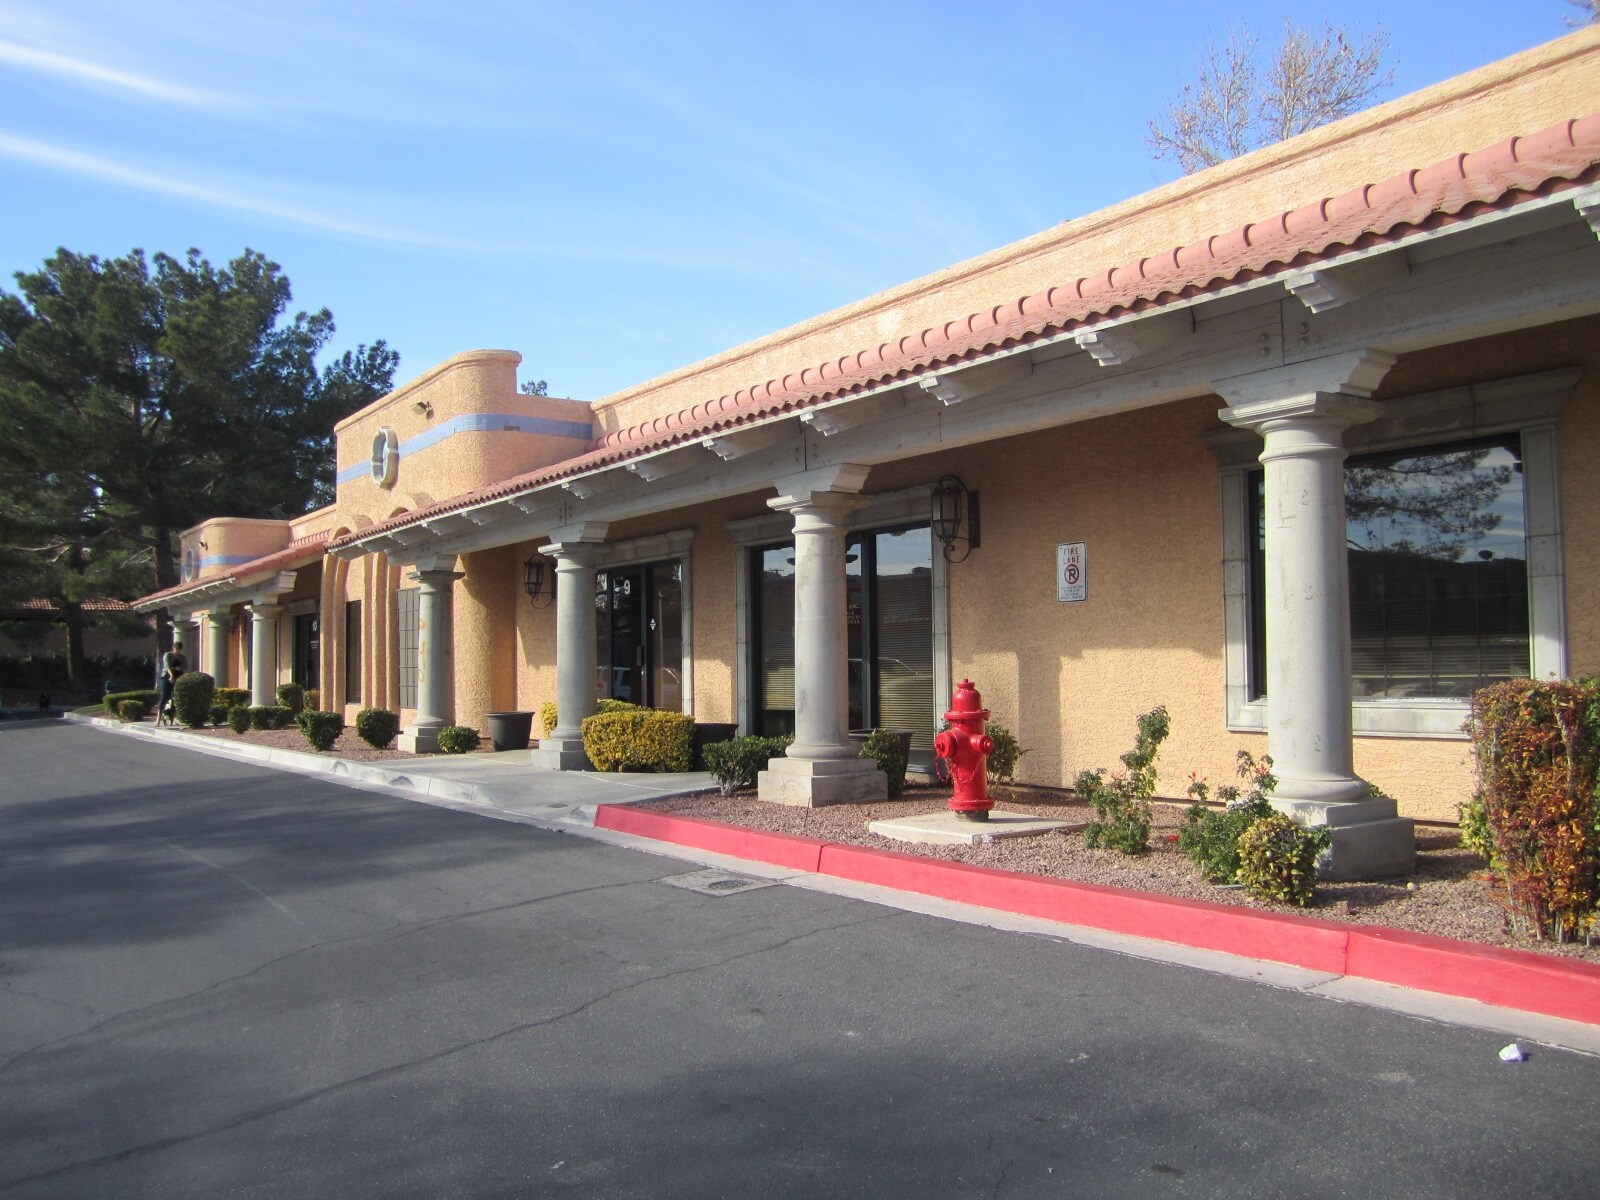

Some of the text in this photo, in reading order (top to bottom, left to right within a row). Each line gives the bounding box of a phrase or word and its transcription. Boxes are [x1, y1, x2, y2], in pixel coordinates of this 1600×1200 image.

[1063, 547, 1079, 556] FIRE
[1063, 555, 1080, 565] LANE
[623, 579, 631, 595] 9
